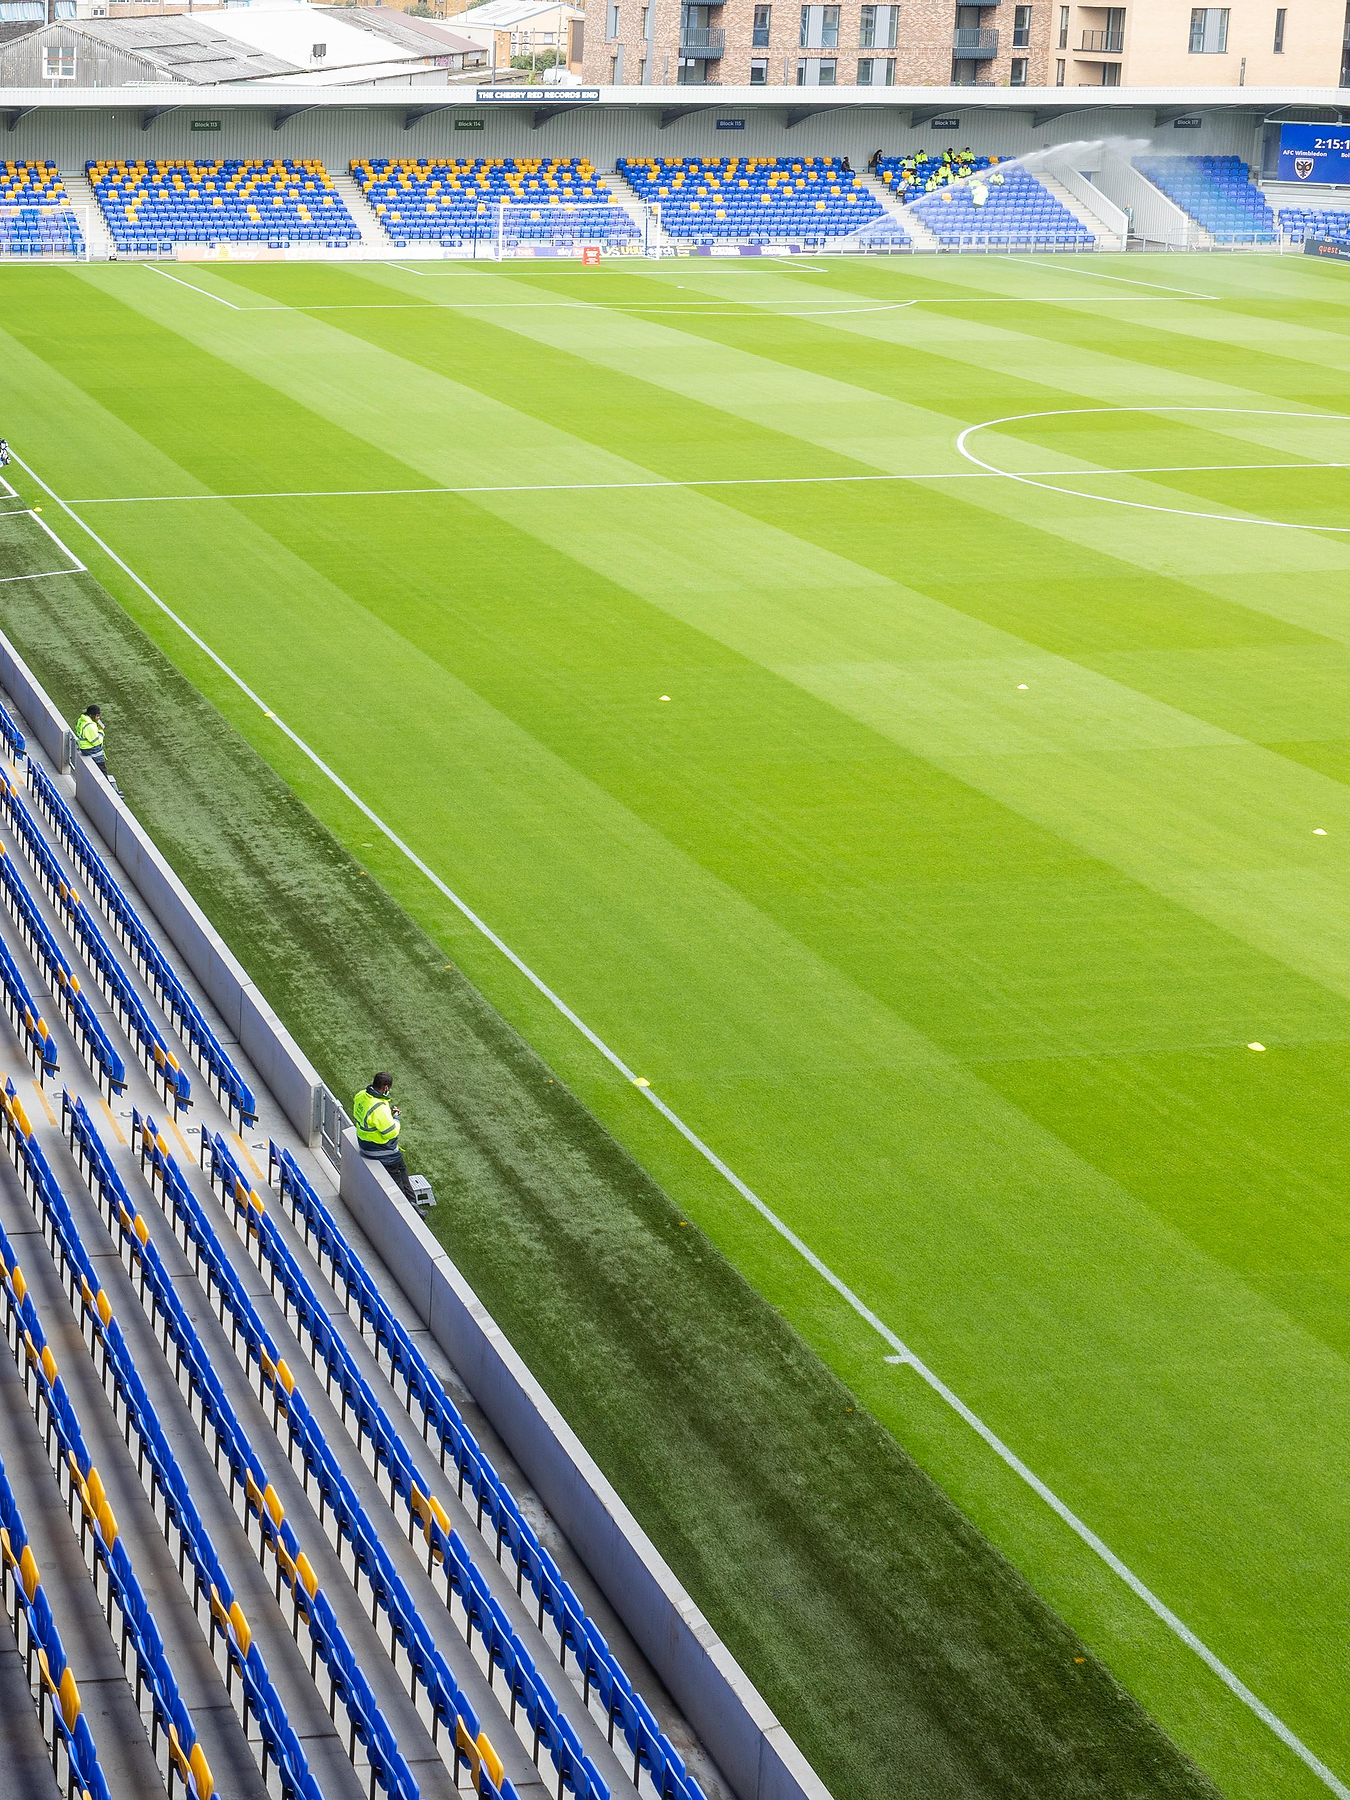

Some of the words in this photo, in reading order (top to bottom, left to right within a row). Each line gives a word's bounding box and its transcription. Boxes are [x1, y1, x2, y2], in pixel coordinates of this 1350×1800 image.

[478, 91, 494, 99] THE
[495, 91, 526, 99] CHERRY
[527, 91, 543, 99] RED
[544, 91, 580, 99] RECORDS
[581, 91, 599, 99] END
[1318, 245, 1339, 255] quest
